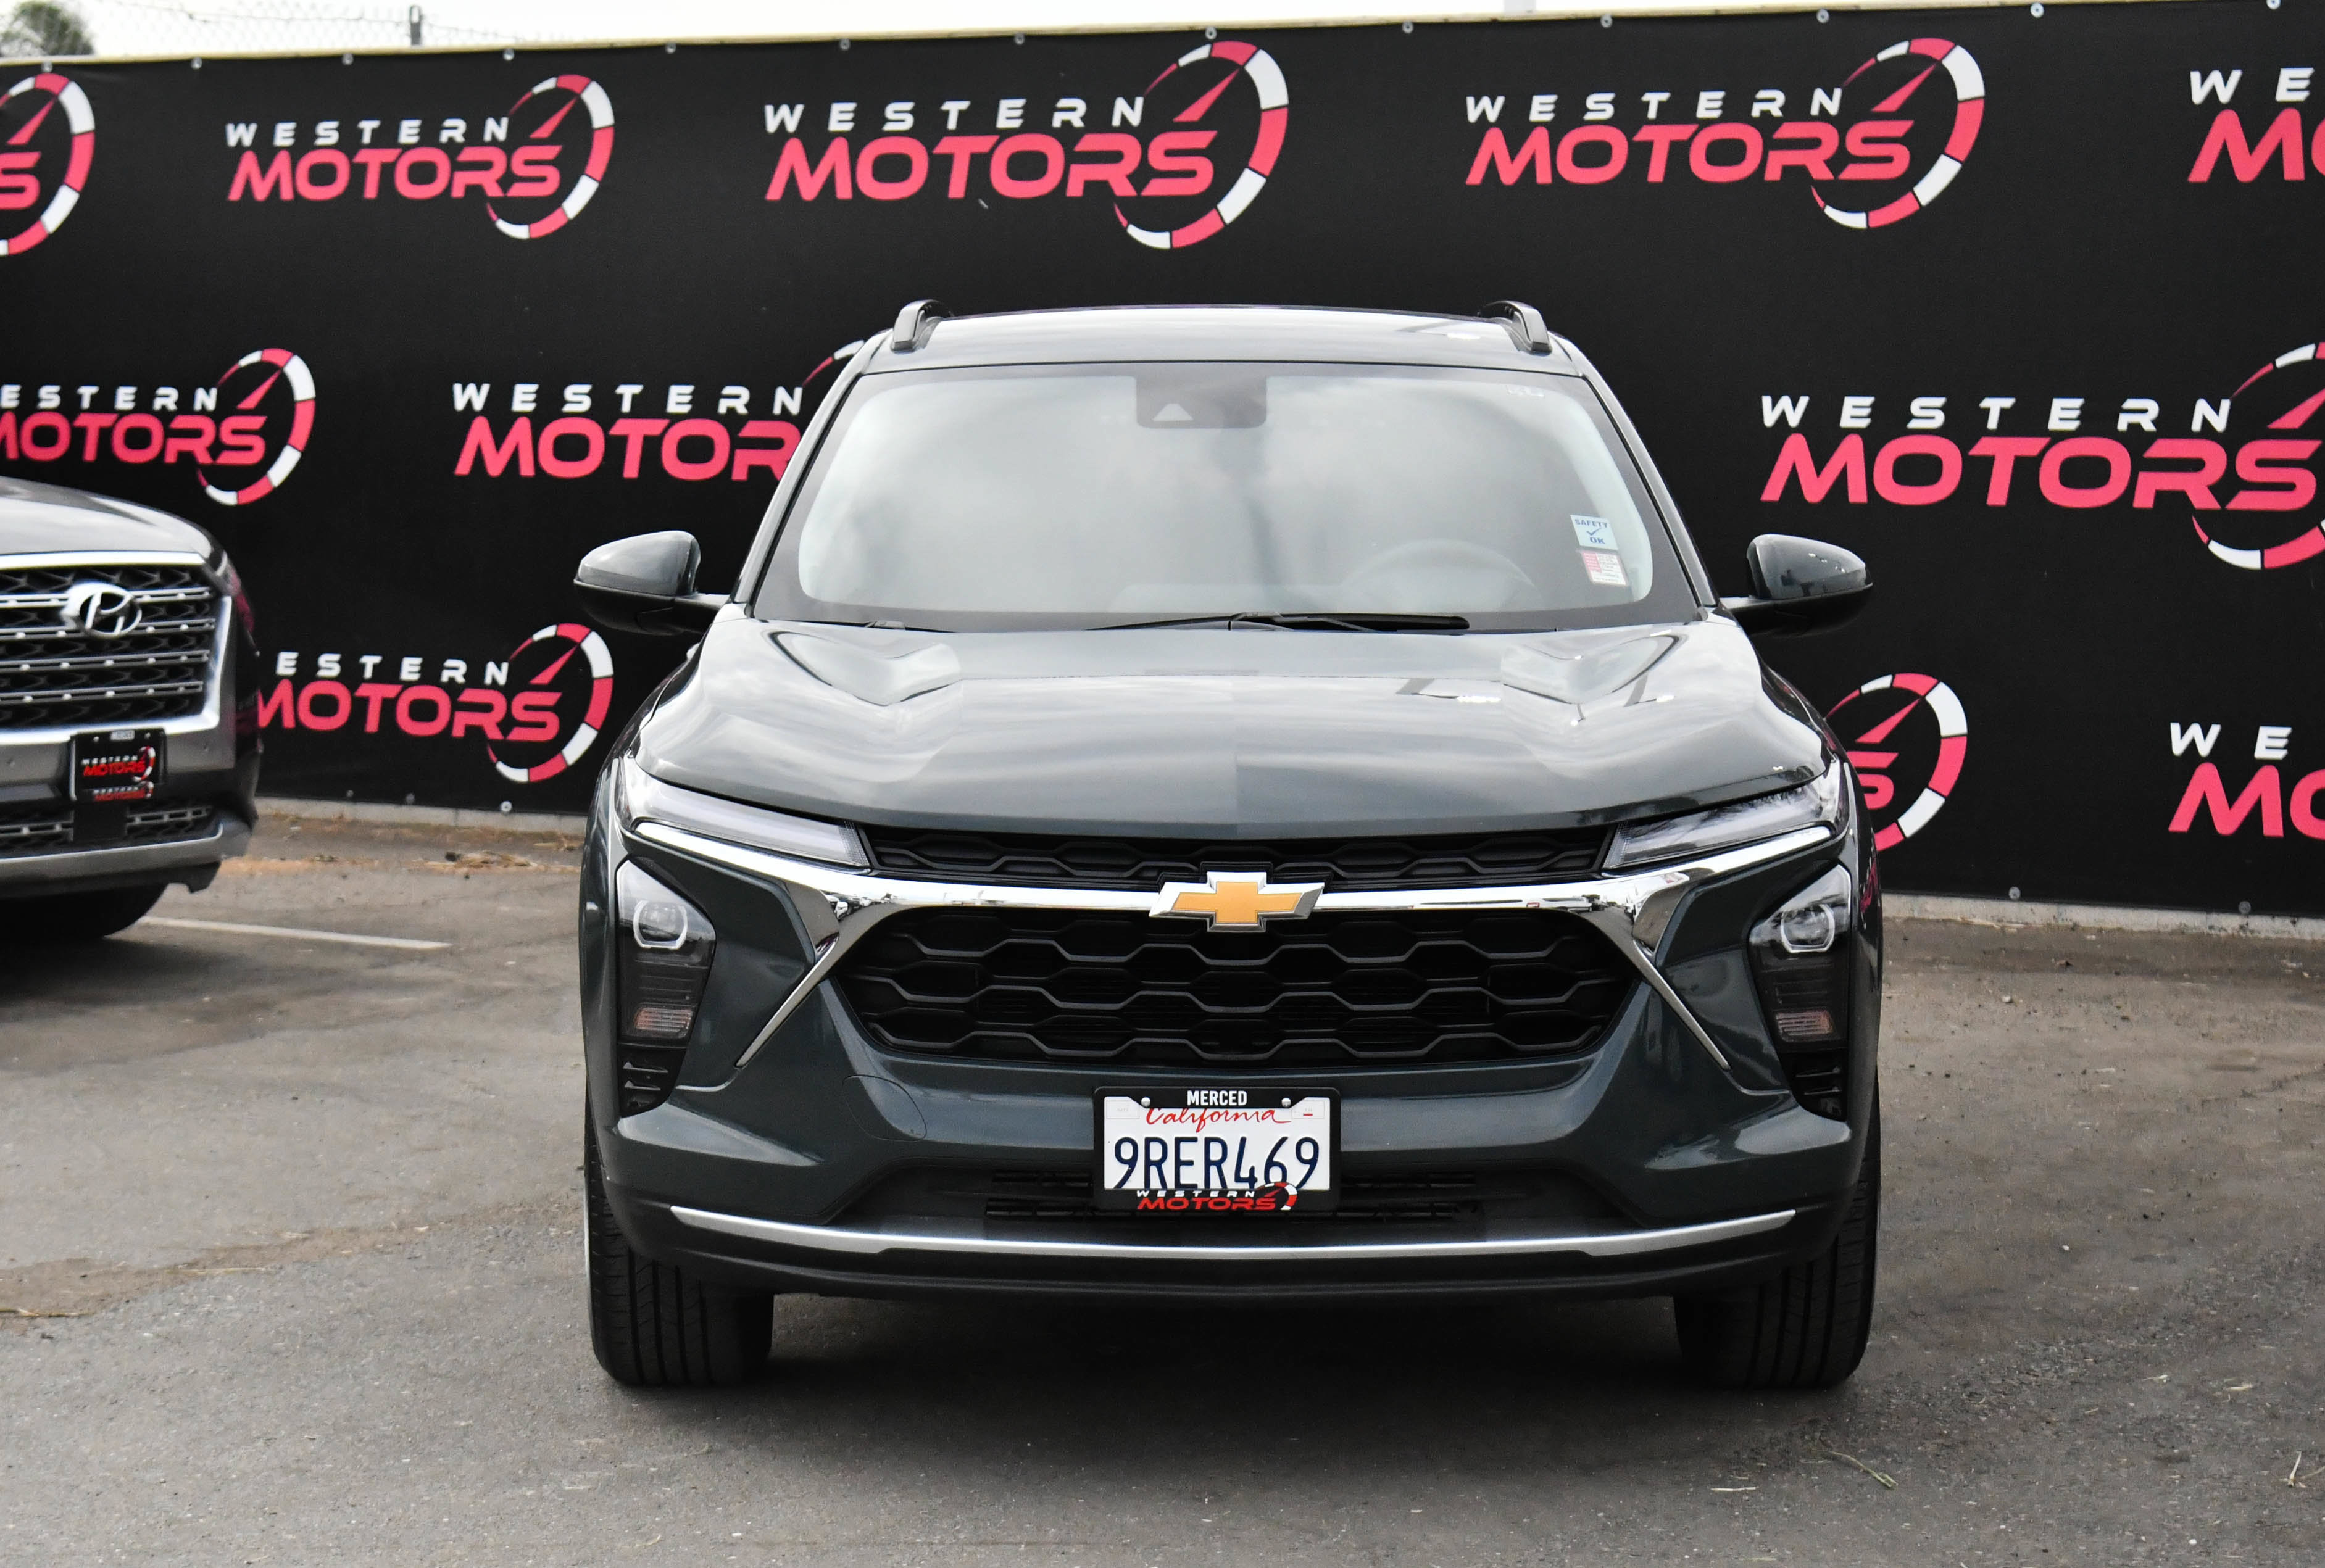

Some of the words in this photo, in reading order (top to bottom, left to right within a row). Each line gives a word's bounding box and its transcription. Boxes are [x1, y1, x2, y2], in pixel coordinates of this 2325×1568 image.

[765, 97, 1144, 133] WESTERN
[1466, 88, 1842, 123] WESTERN
[227, 117, 508, 147] WESTERN
[765, 131, 1217, 201] MOTORS
[1466, 120, 1913, 185] MOTORS
[228, 145, 562, 201] MOTORS
[0, 385, 217, 411] ESTERN
[454, 383, 802, 415] WESTERN
[1762, 396, 2231, 432] WESTERN
[1761, 433, 2321, 510] MOTORS
[1574, 518, 1608, 528] SAFETY
[1590, 536, 1605, 544] OK
[277, 652, 509, 685] ESTERN
[1187, 1090, 1247, 1106] MERCED
[1146, 1108, 1291, 1133] California
[1114, 1136, 1320, 1190] 9RER469
[1136, 1190, 1255, 1198] WESTERN
[1137, 1197, 1276, 1211] MOTORS
